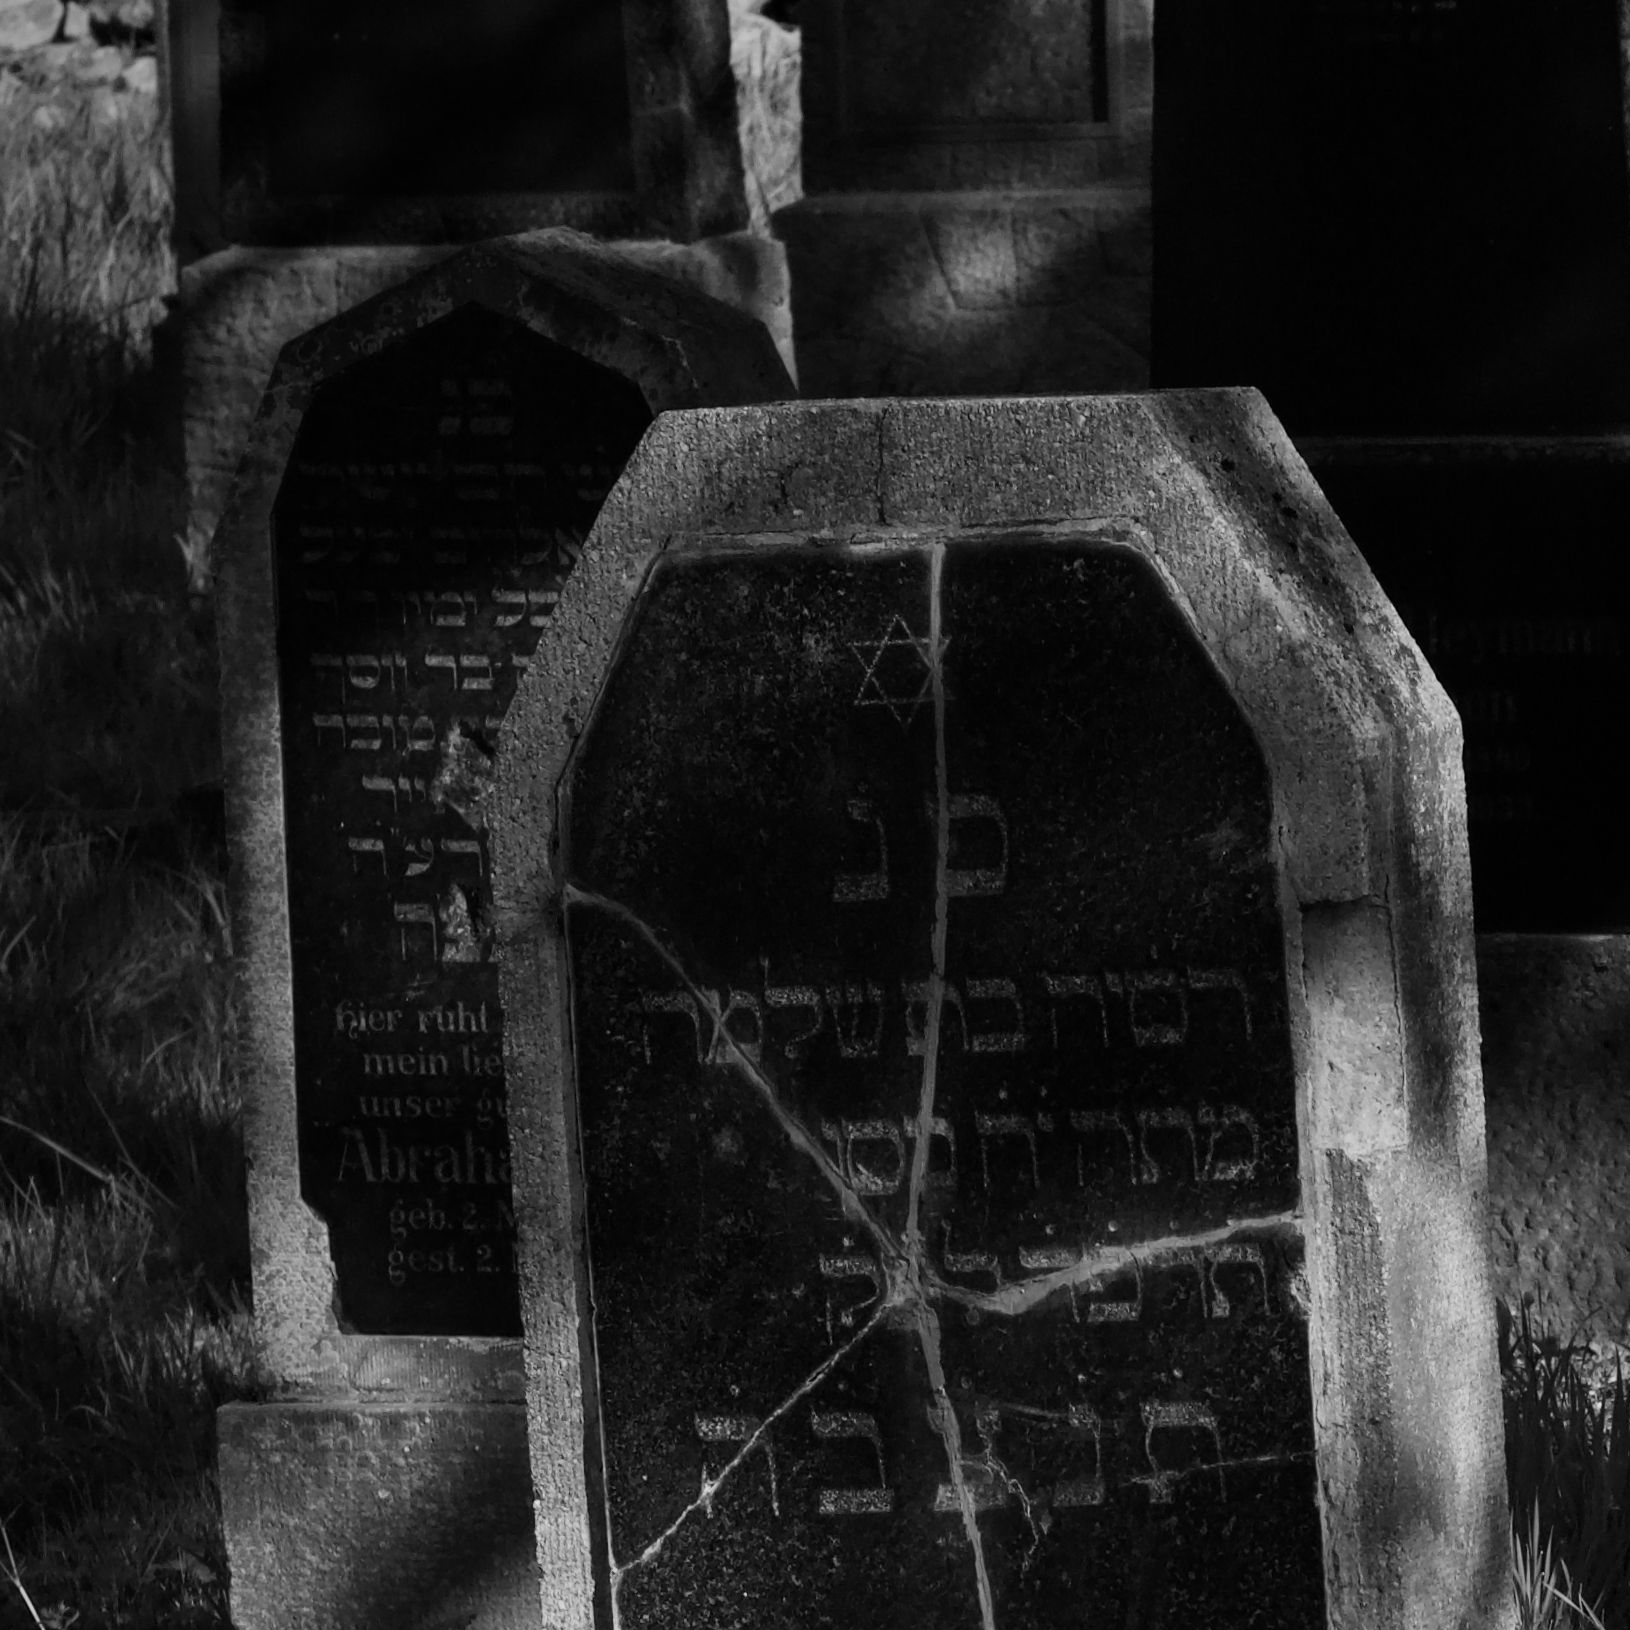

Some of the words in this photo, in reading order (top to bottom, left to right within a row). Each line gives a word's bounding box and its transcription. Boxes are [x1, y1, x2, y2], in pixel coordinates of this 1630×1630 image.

[416, 999, 490, 1035] ruht
[361, 1045, 450, 1078] mein
[357, 1093, 462, 1120] unser
